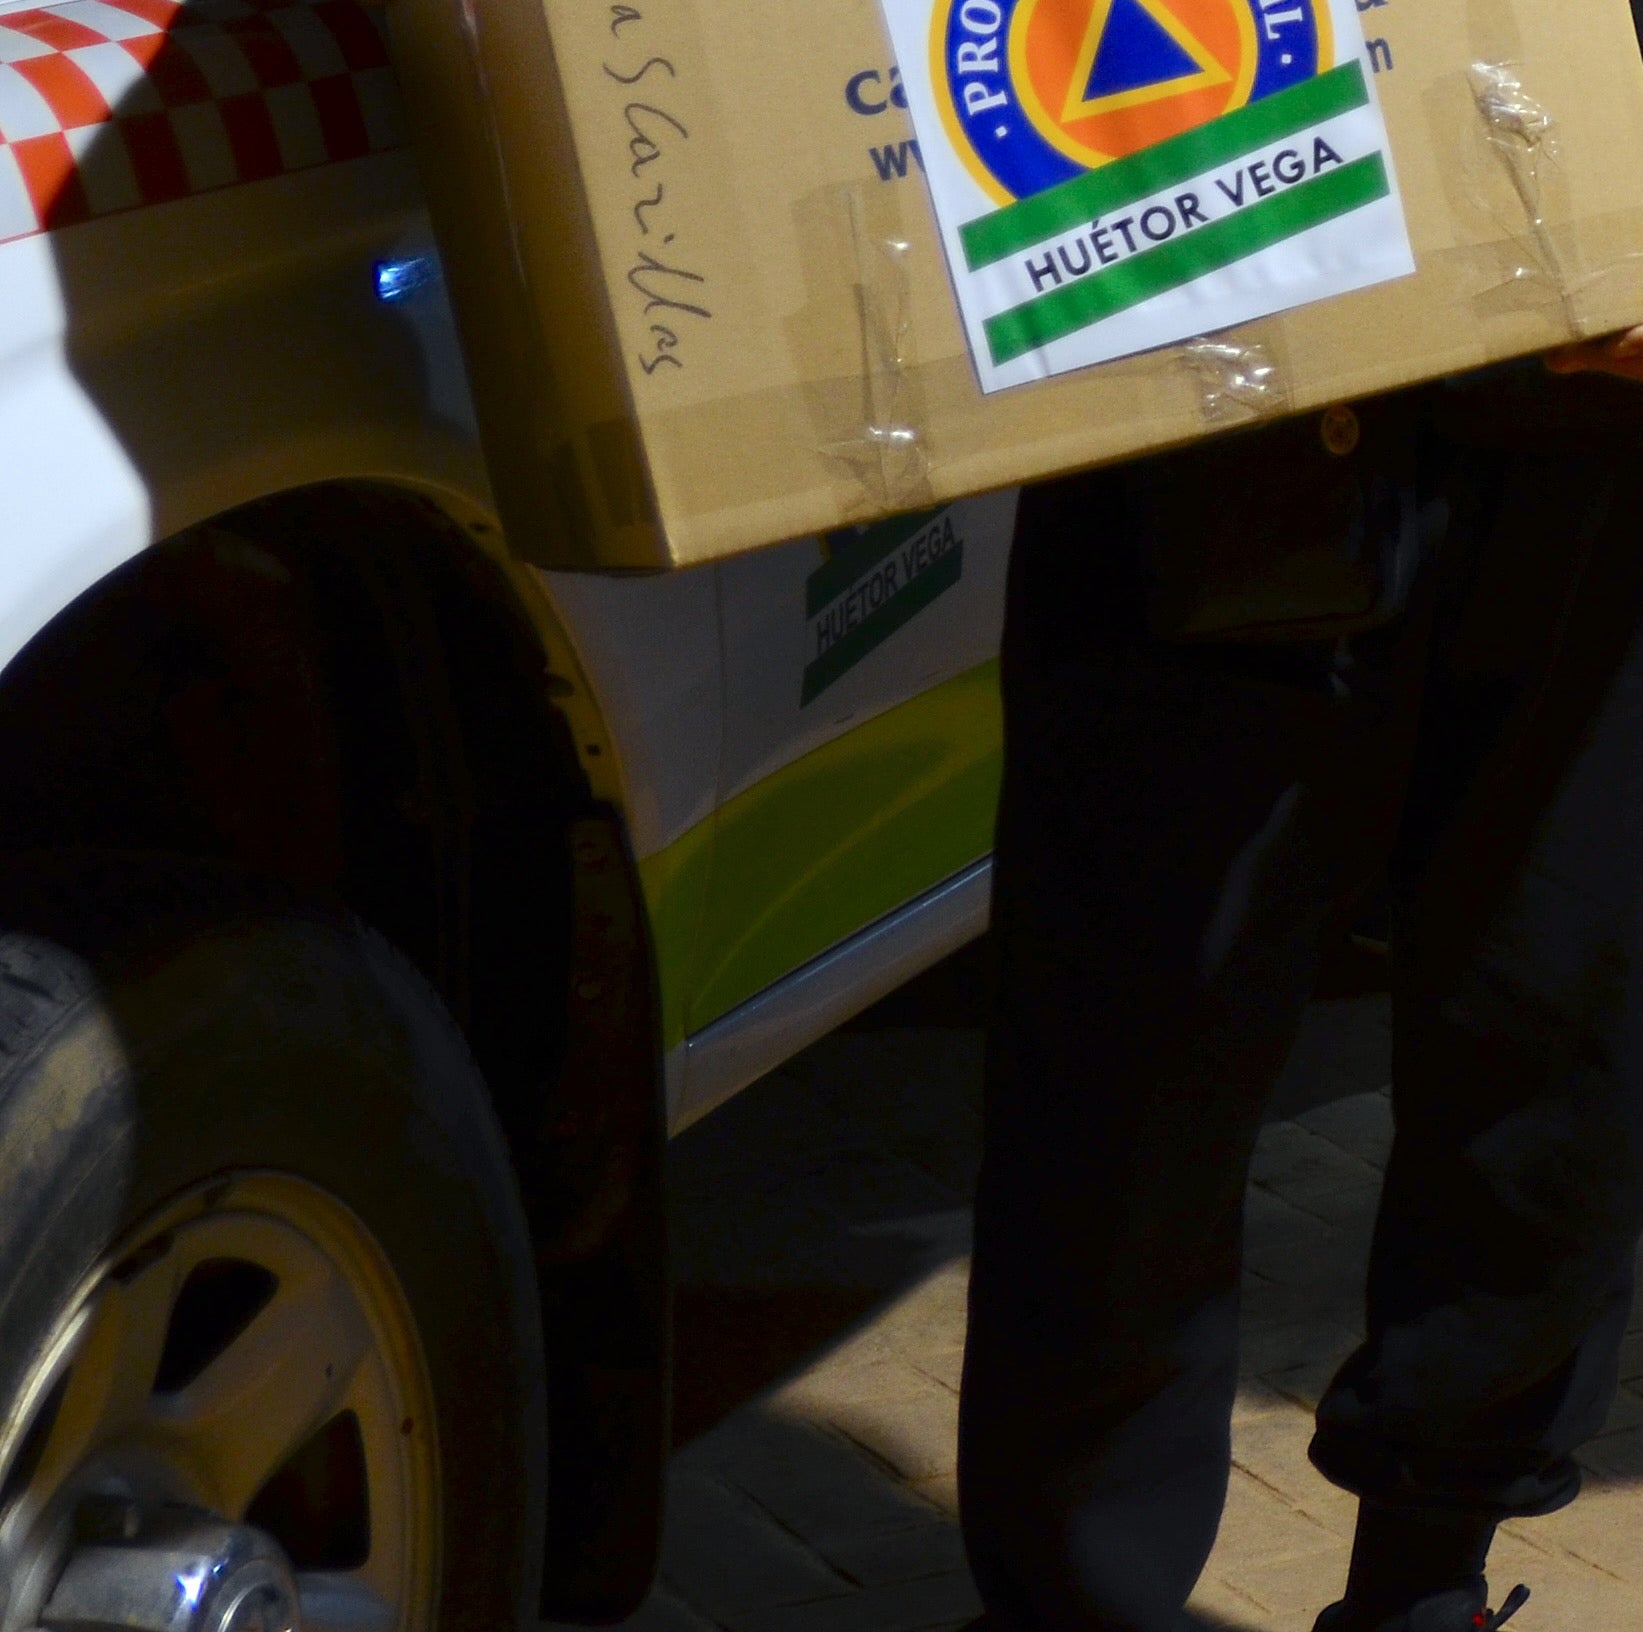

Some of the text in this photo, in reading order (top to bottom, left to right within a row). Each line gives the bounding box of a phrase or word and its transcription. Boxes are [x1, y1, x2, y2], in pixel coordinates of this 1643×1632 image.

[1024, 136, 1345, 293] HUÉTOR VEGA
[901, 517, 956, 581] VEGA
